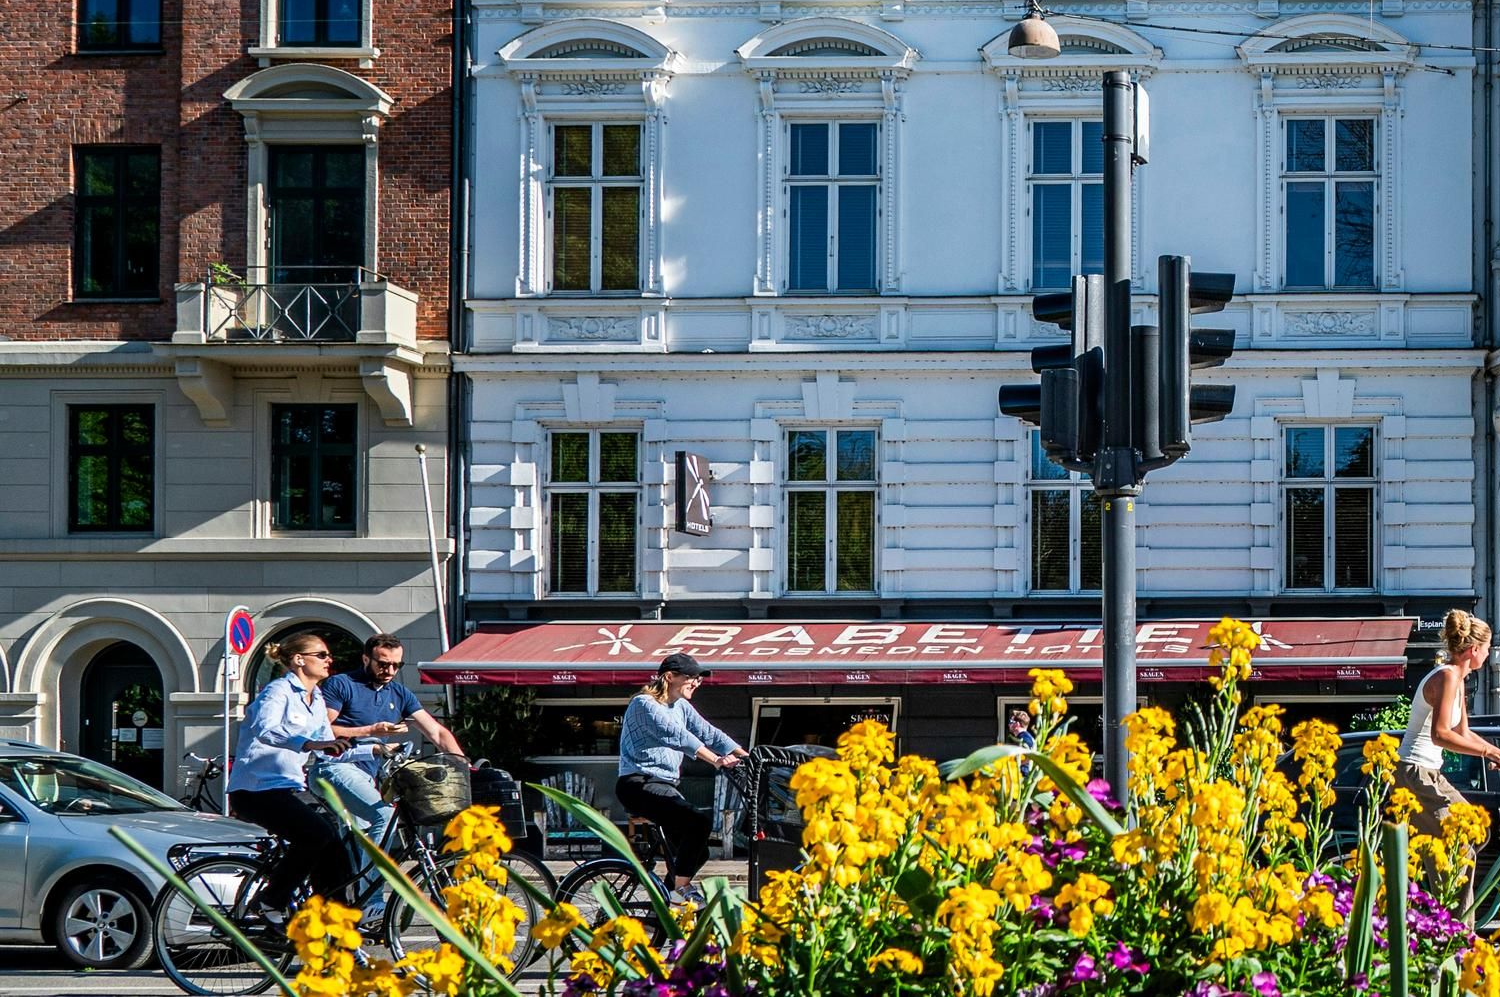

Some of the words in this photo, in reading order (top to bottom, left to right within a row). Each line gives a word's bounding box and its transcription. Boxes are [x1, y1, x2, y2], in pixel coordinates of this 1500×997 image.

[665, 624, 1200, 646] BABETTE
[652, 645, 984, 657] GULDSMEDEN
[1004, 644, 1191, 655] HOTLS
